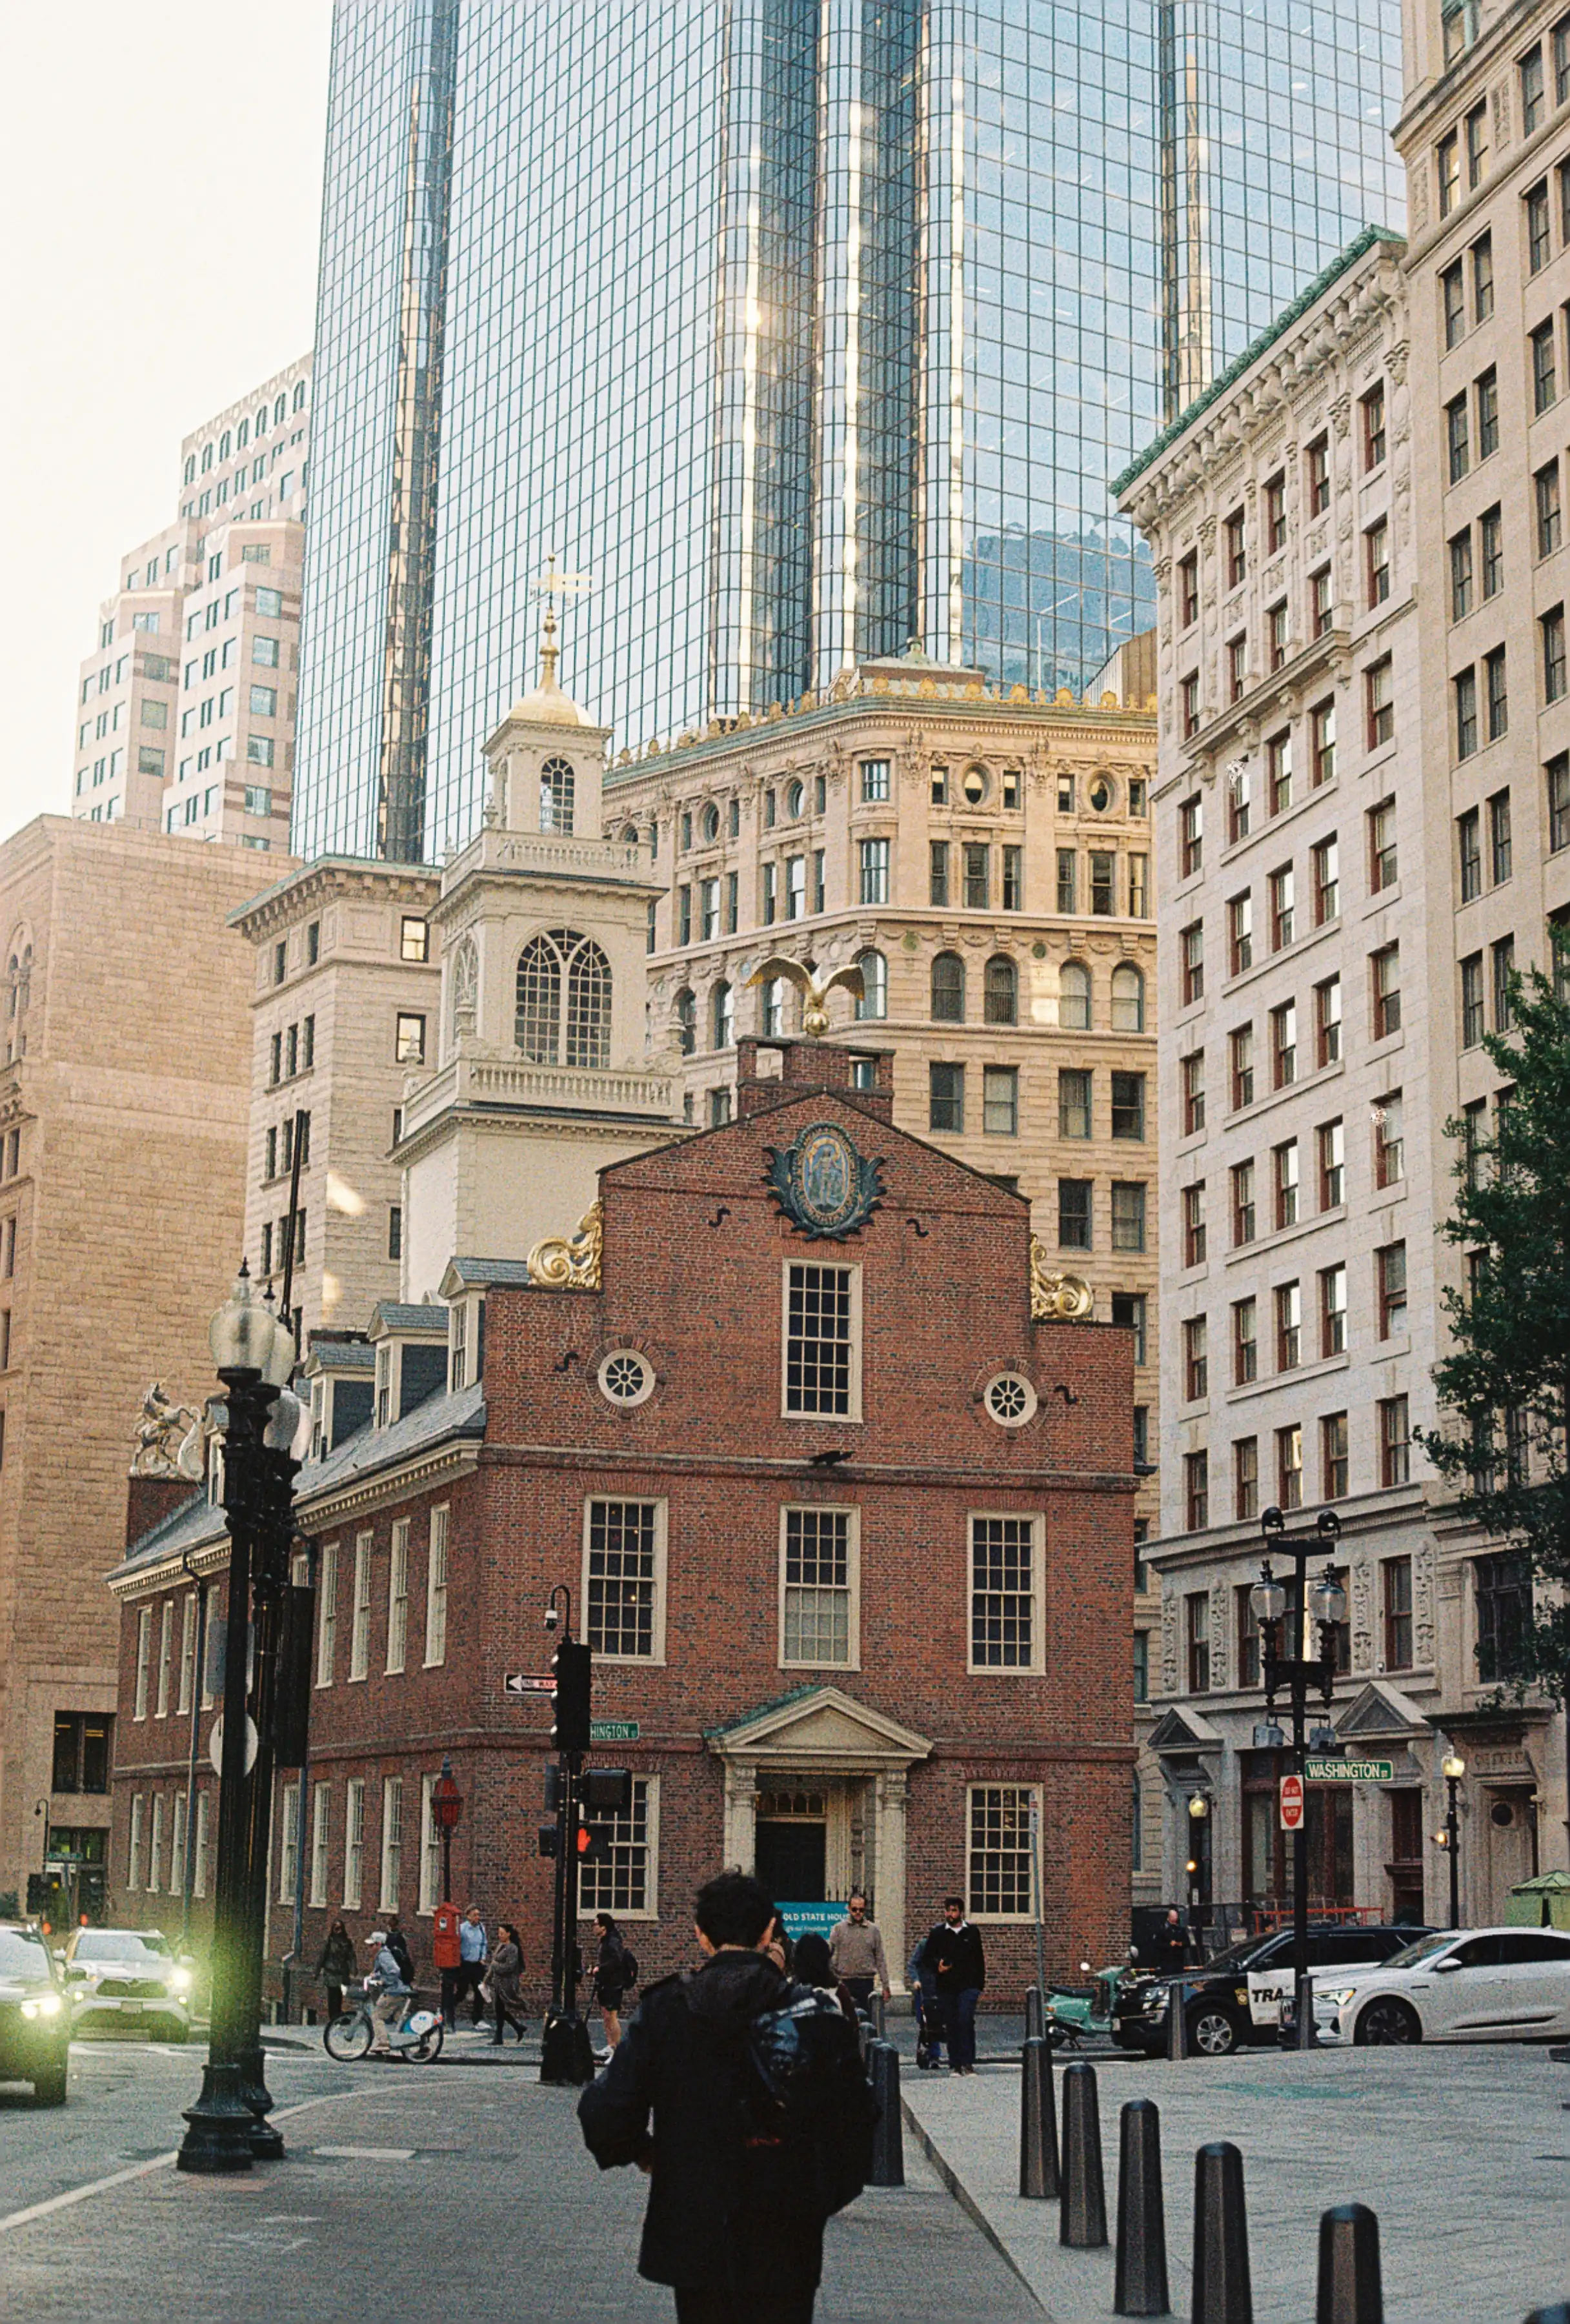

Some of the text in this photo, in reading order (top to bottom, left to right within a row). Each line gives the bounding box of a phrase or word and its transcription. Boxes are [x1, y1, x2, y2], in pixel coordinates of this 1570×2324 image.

[539, 1680, 554, 1688] WAY
[590, 1724, 629, 1738] HINGTON
[1308, 1763, 1380, 1778] WASHINGTON
[1285, 1808, 1299, 1817] ENTER
[783, 1913, 850, 1921] OLD STATE HOUS
[1252, 1987, 1283, 2003] TRA
